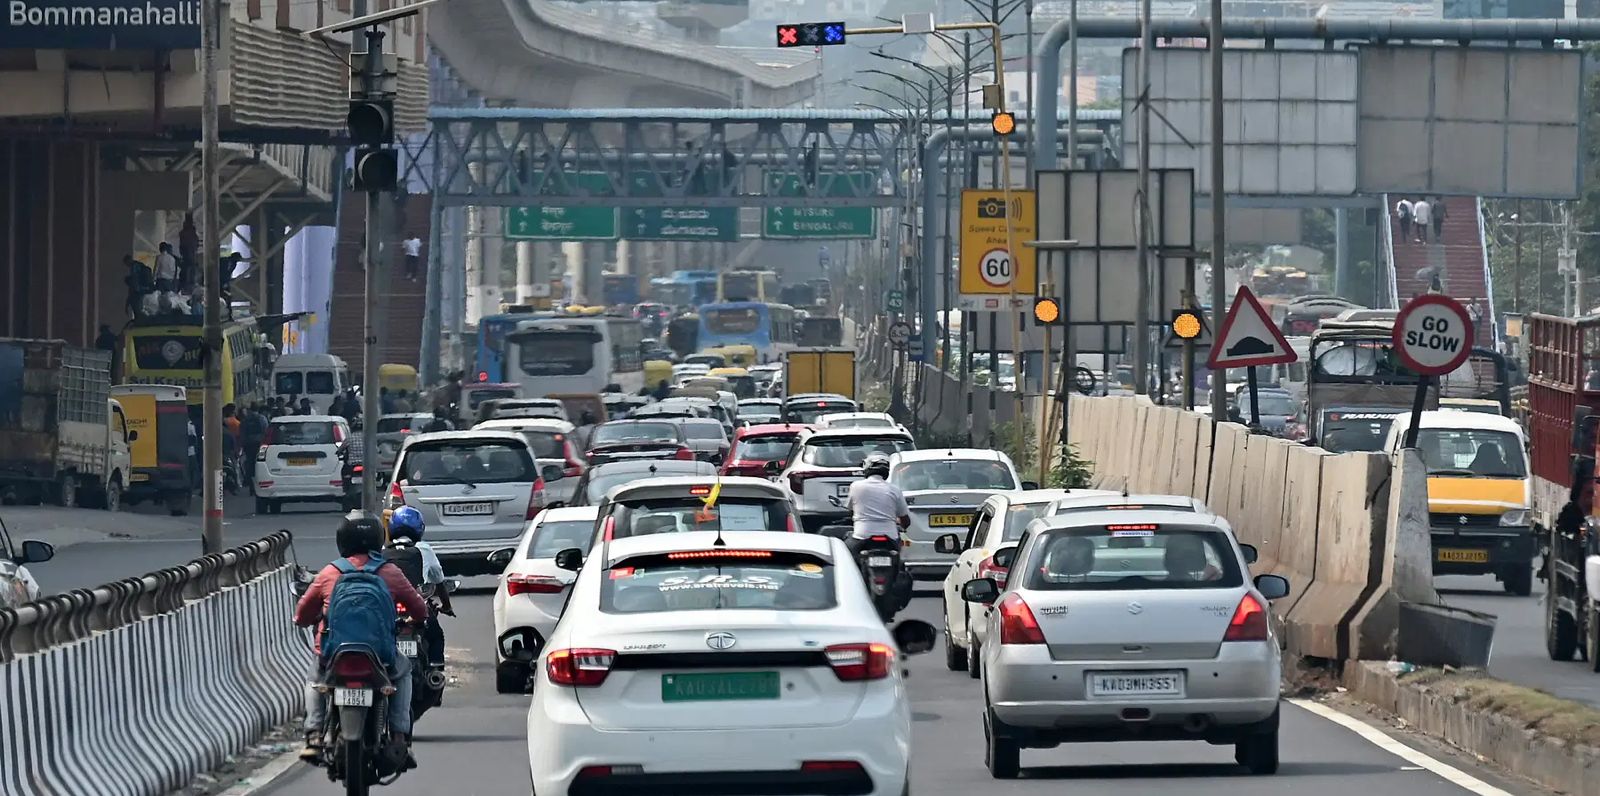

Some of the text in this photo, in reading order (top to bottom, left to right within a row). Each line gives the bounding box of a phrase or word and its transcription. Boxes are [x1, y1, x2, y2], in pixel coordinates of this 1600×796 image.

[10, 0, 201, 26] Bommanahalli
[986, 258, 1012, 278] 60
[1421, 315, 1449, 333] GO
[1405, 330, 1460, 353] SLOW
